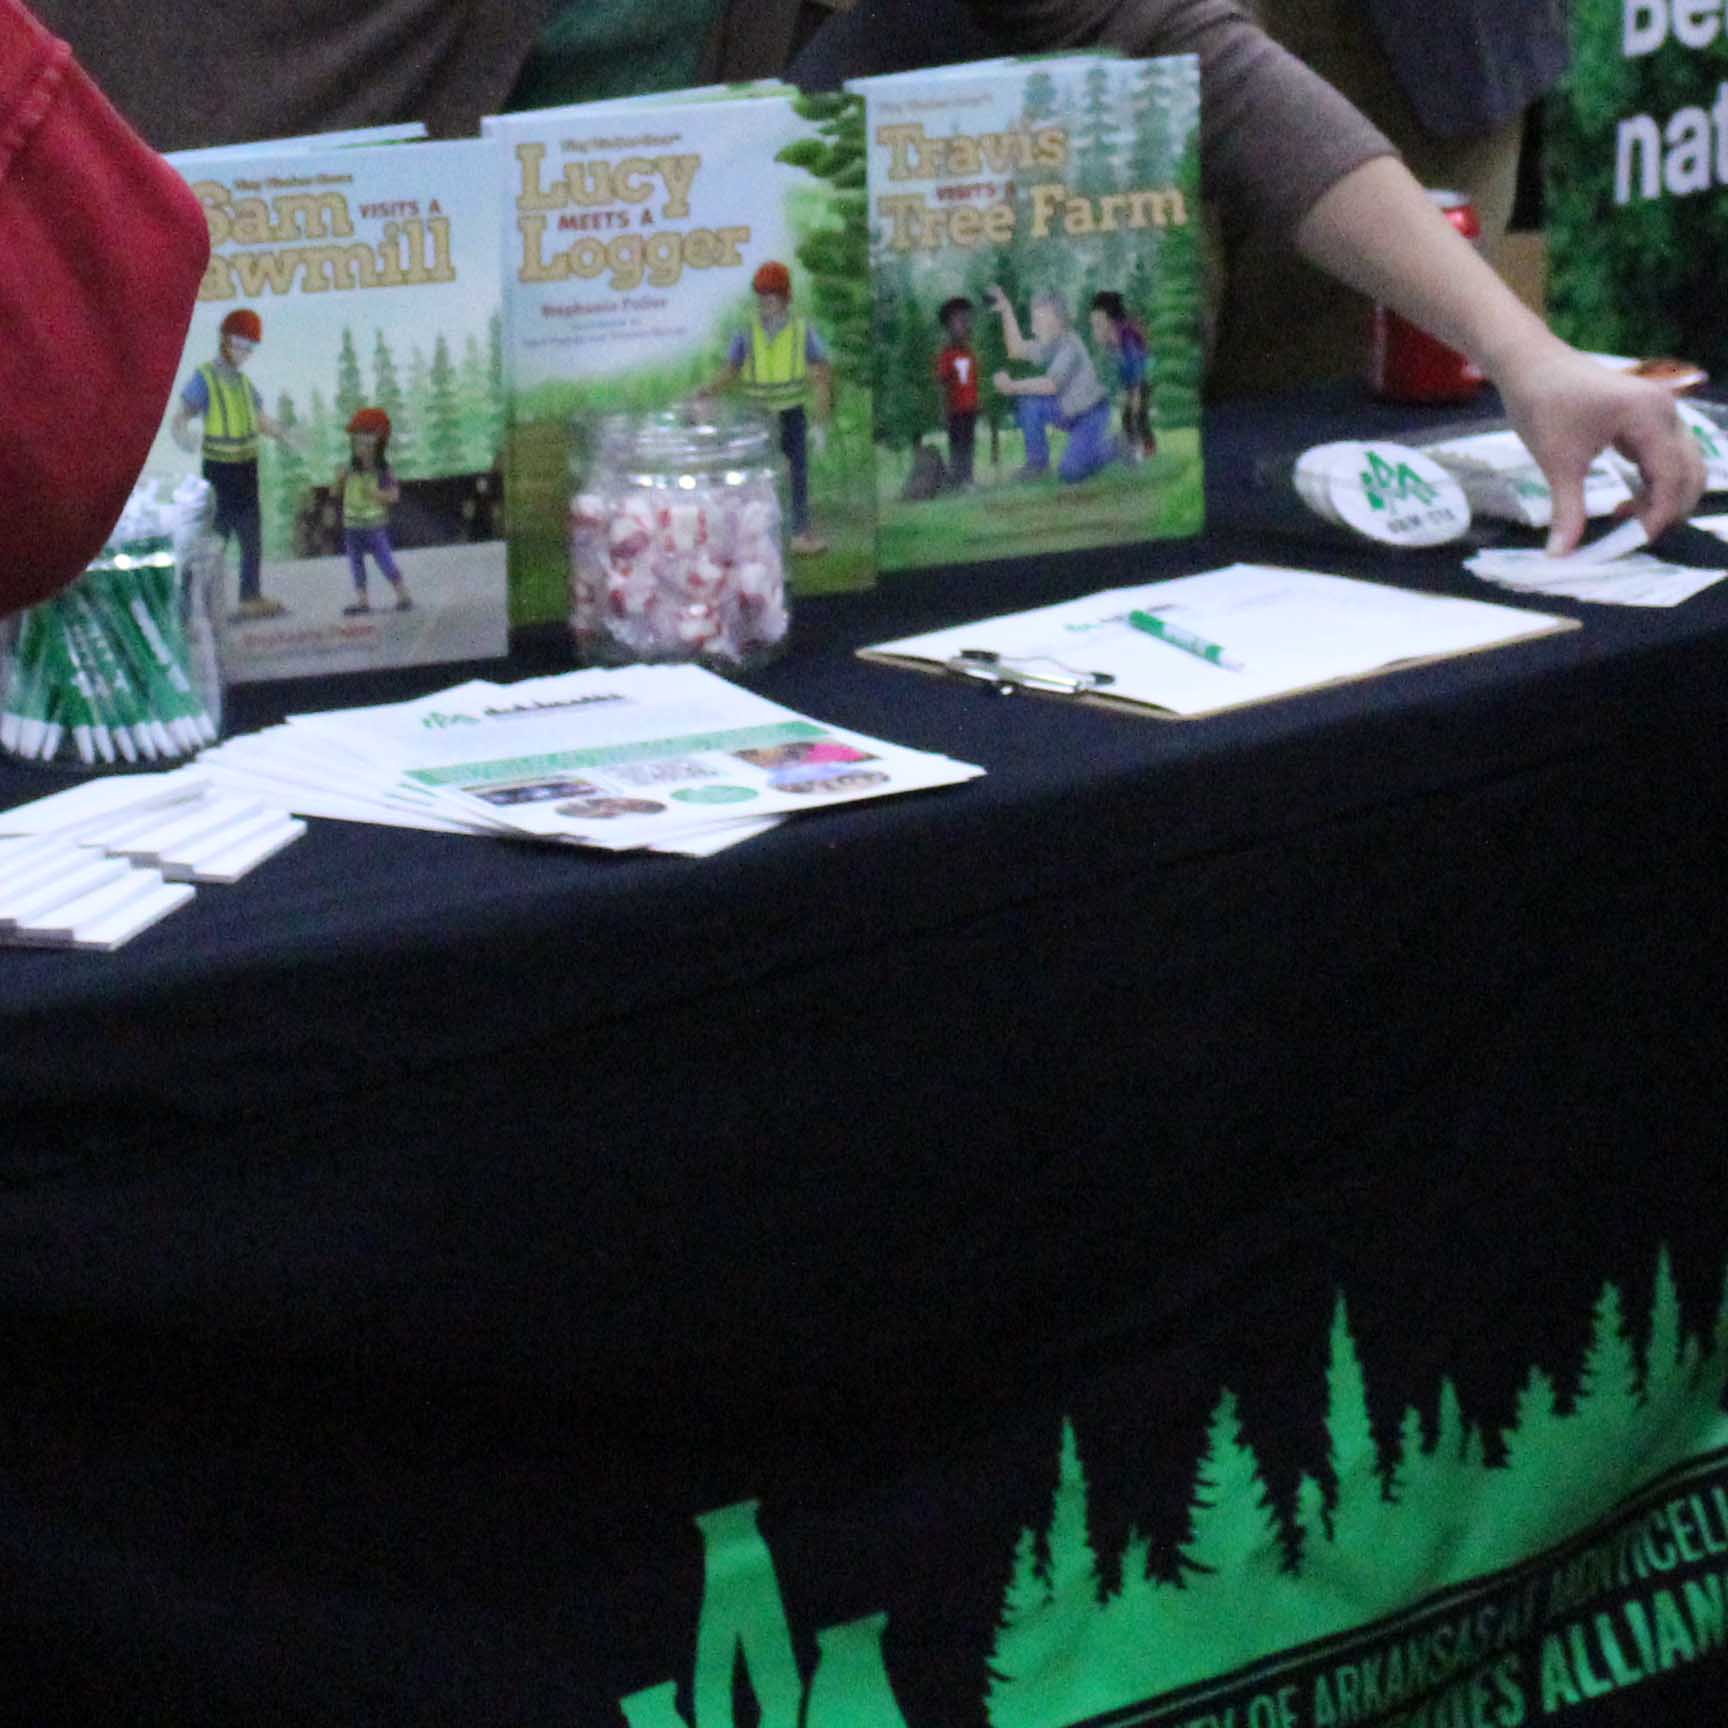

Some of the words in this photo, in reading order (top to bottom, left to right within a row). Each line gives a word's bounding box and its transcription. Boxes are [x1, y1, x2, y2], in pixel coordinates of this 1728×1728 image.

[515, 143, 701, 219] Lucy
[877, 121, 1069, 182] Travis
[191, 180, 354, 249] Sam
[360, 199, 420, 219] VISITS
[429, 197, 442, 214] A
[558, 210, 630, 231] MEETS
[641, 208, 654, 226] A
[877, 193, 1017, 251] Tree
[1029, 182, 1188, 239] Farm
[197, 215, 457, 302] awmill
[517, 215, 752, 292] Logger
